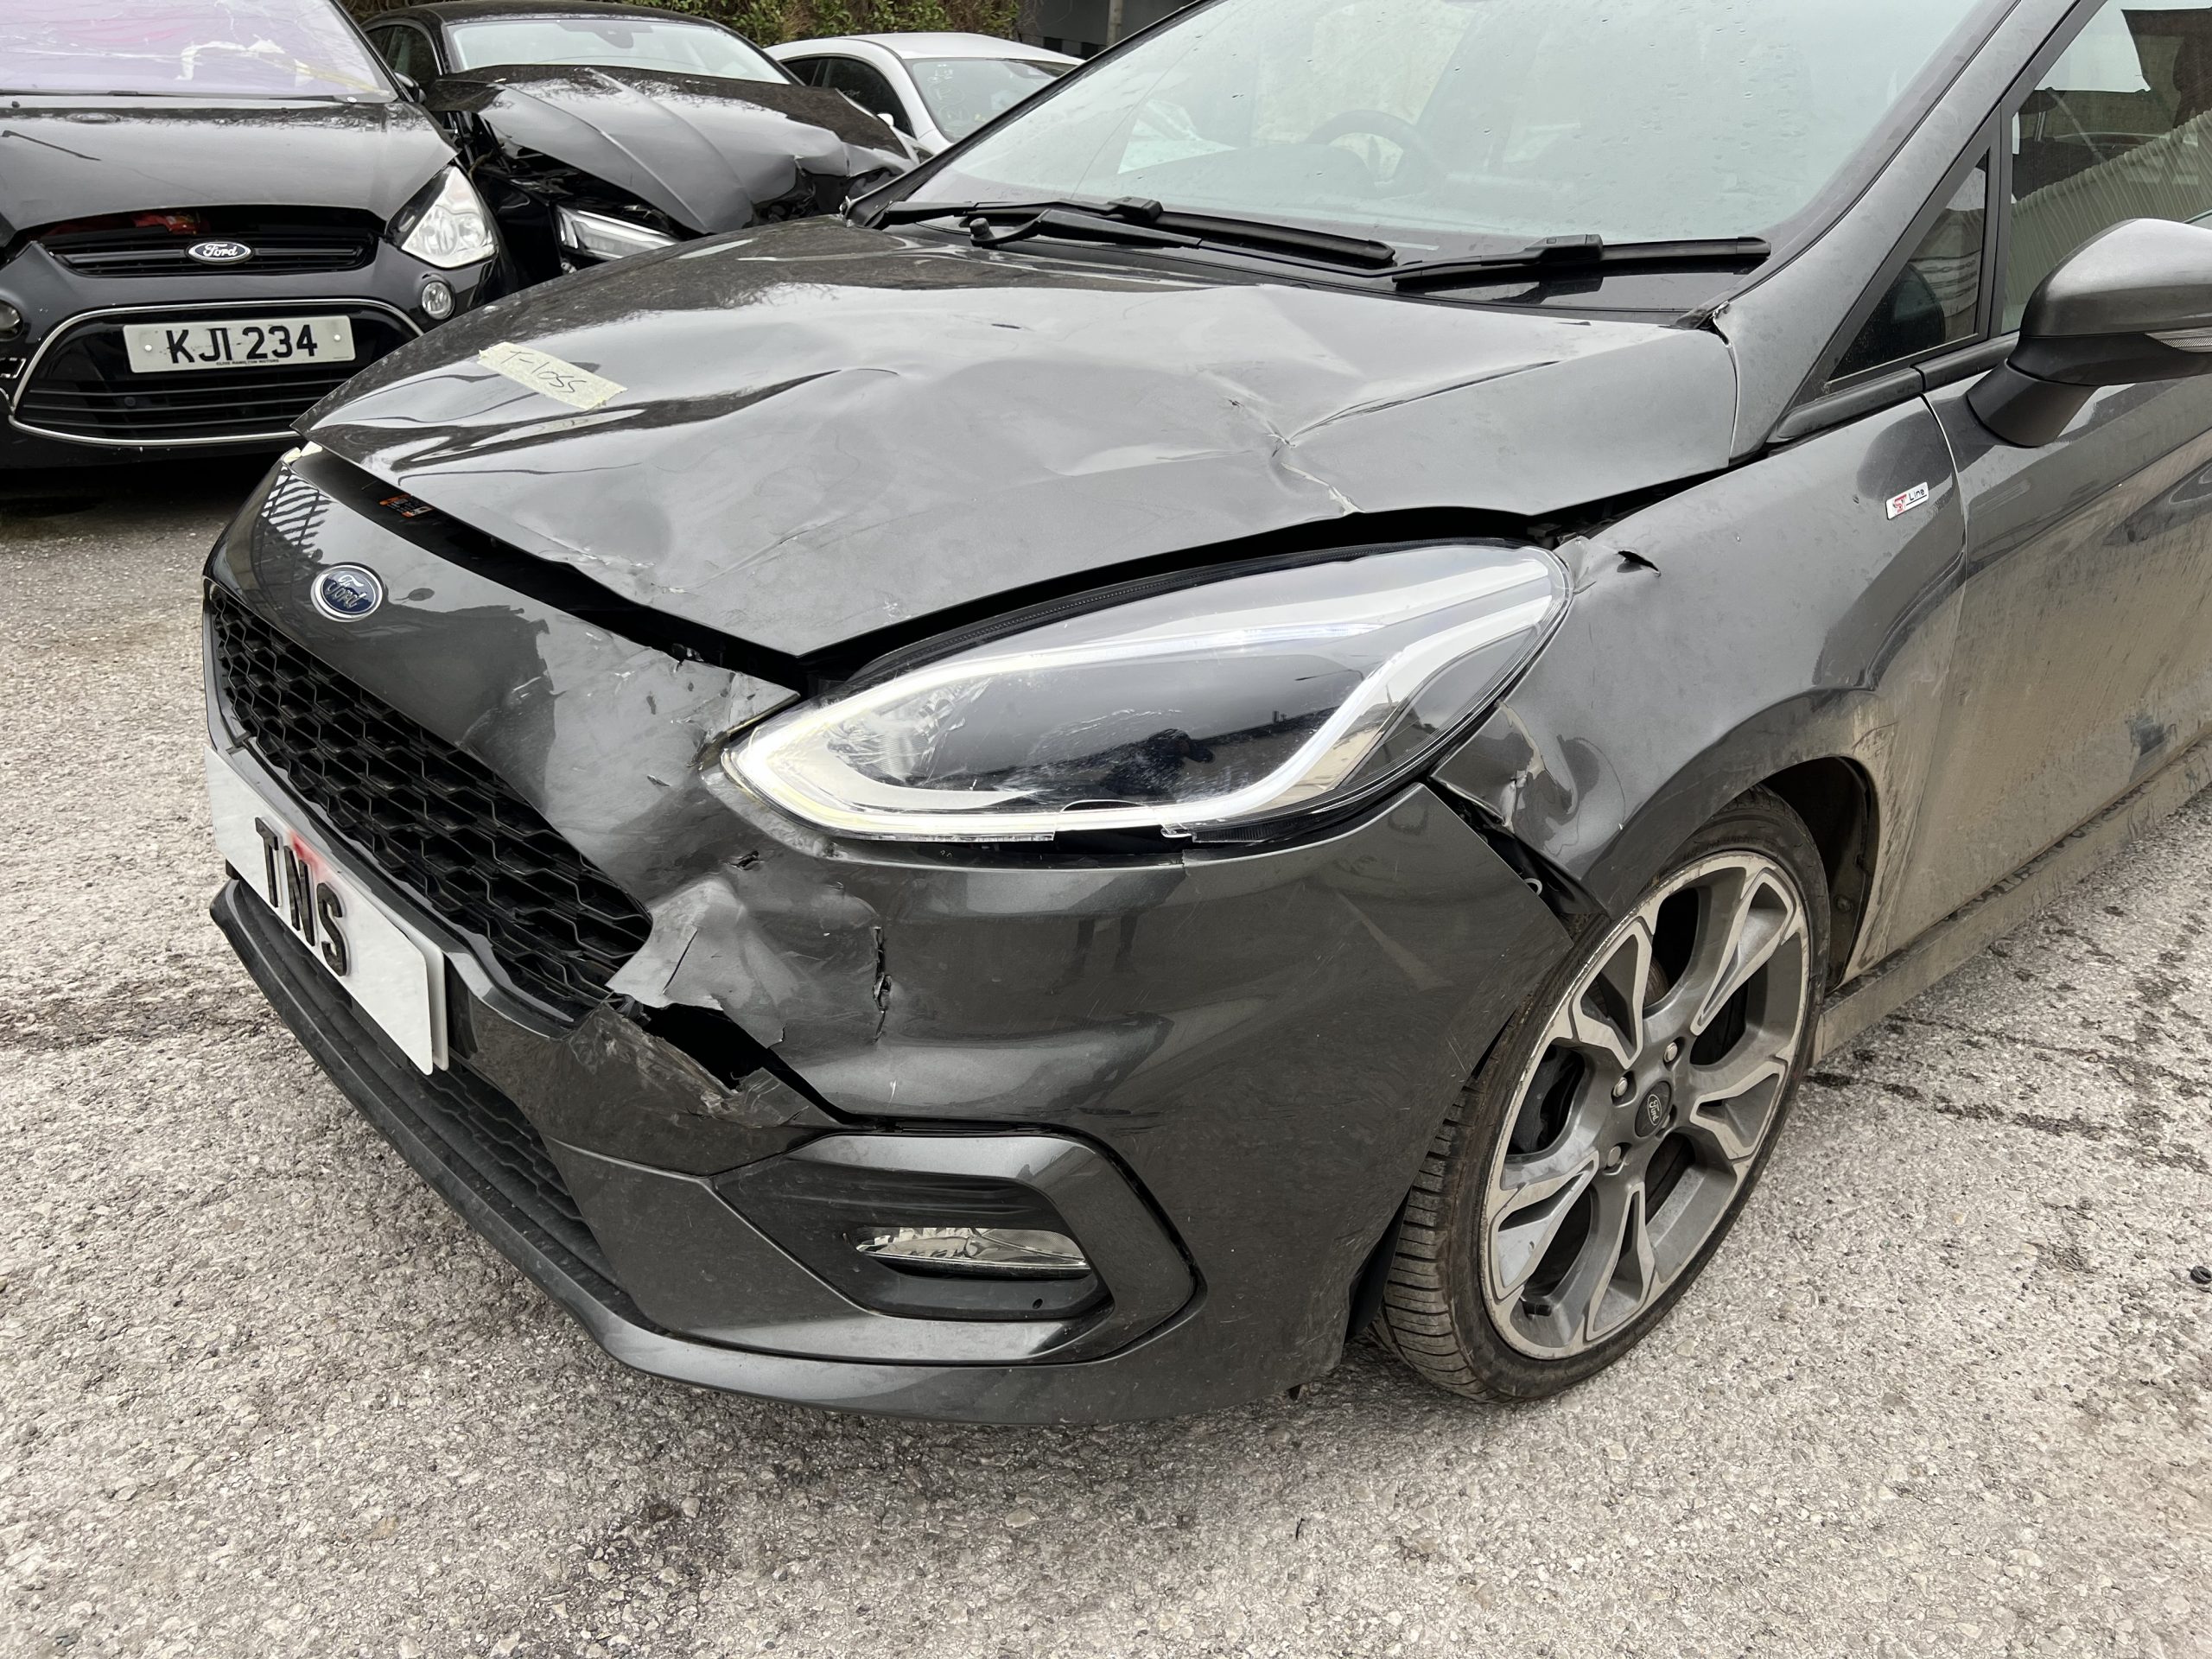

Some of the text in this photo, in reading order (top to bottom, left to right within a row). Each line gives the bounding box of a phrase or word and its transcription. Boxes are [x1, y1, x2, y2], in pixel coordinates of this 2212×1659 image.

[202, 243, 238, 257] Ford
[242, 324, 318, 359] 234
[323, 574, 367, 609] Ford
[255, 817, 349, 976] TNS
[1649, 1099, 1660, 1122] Ford
